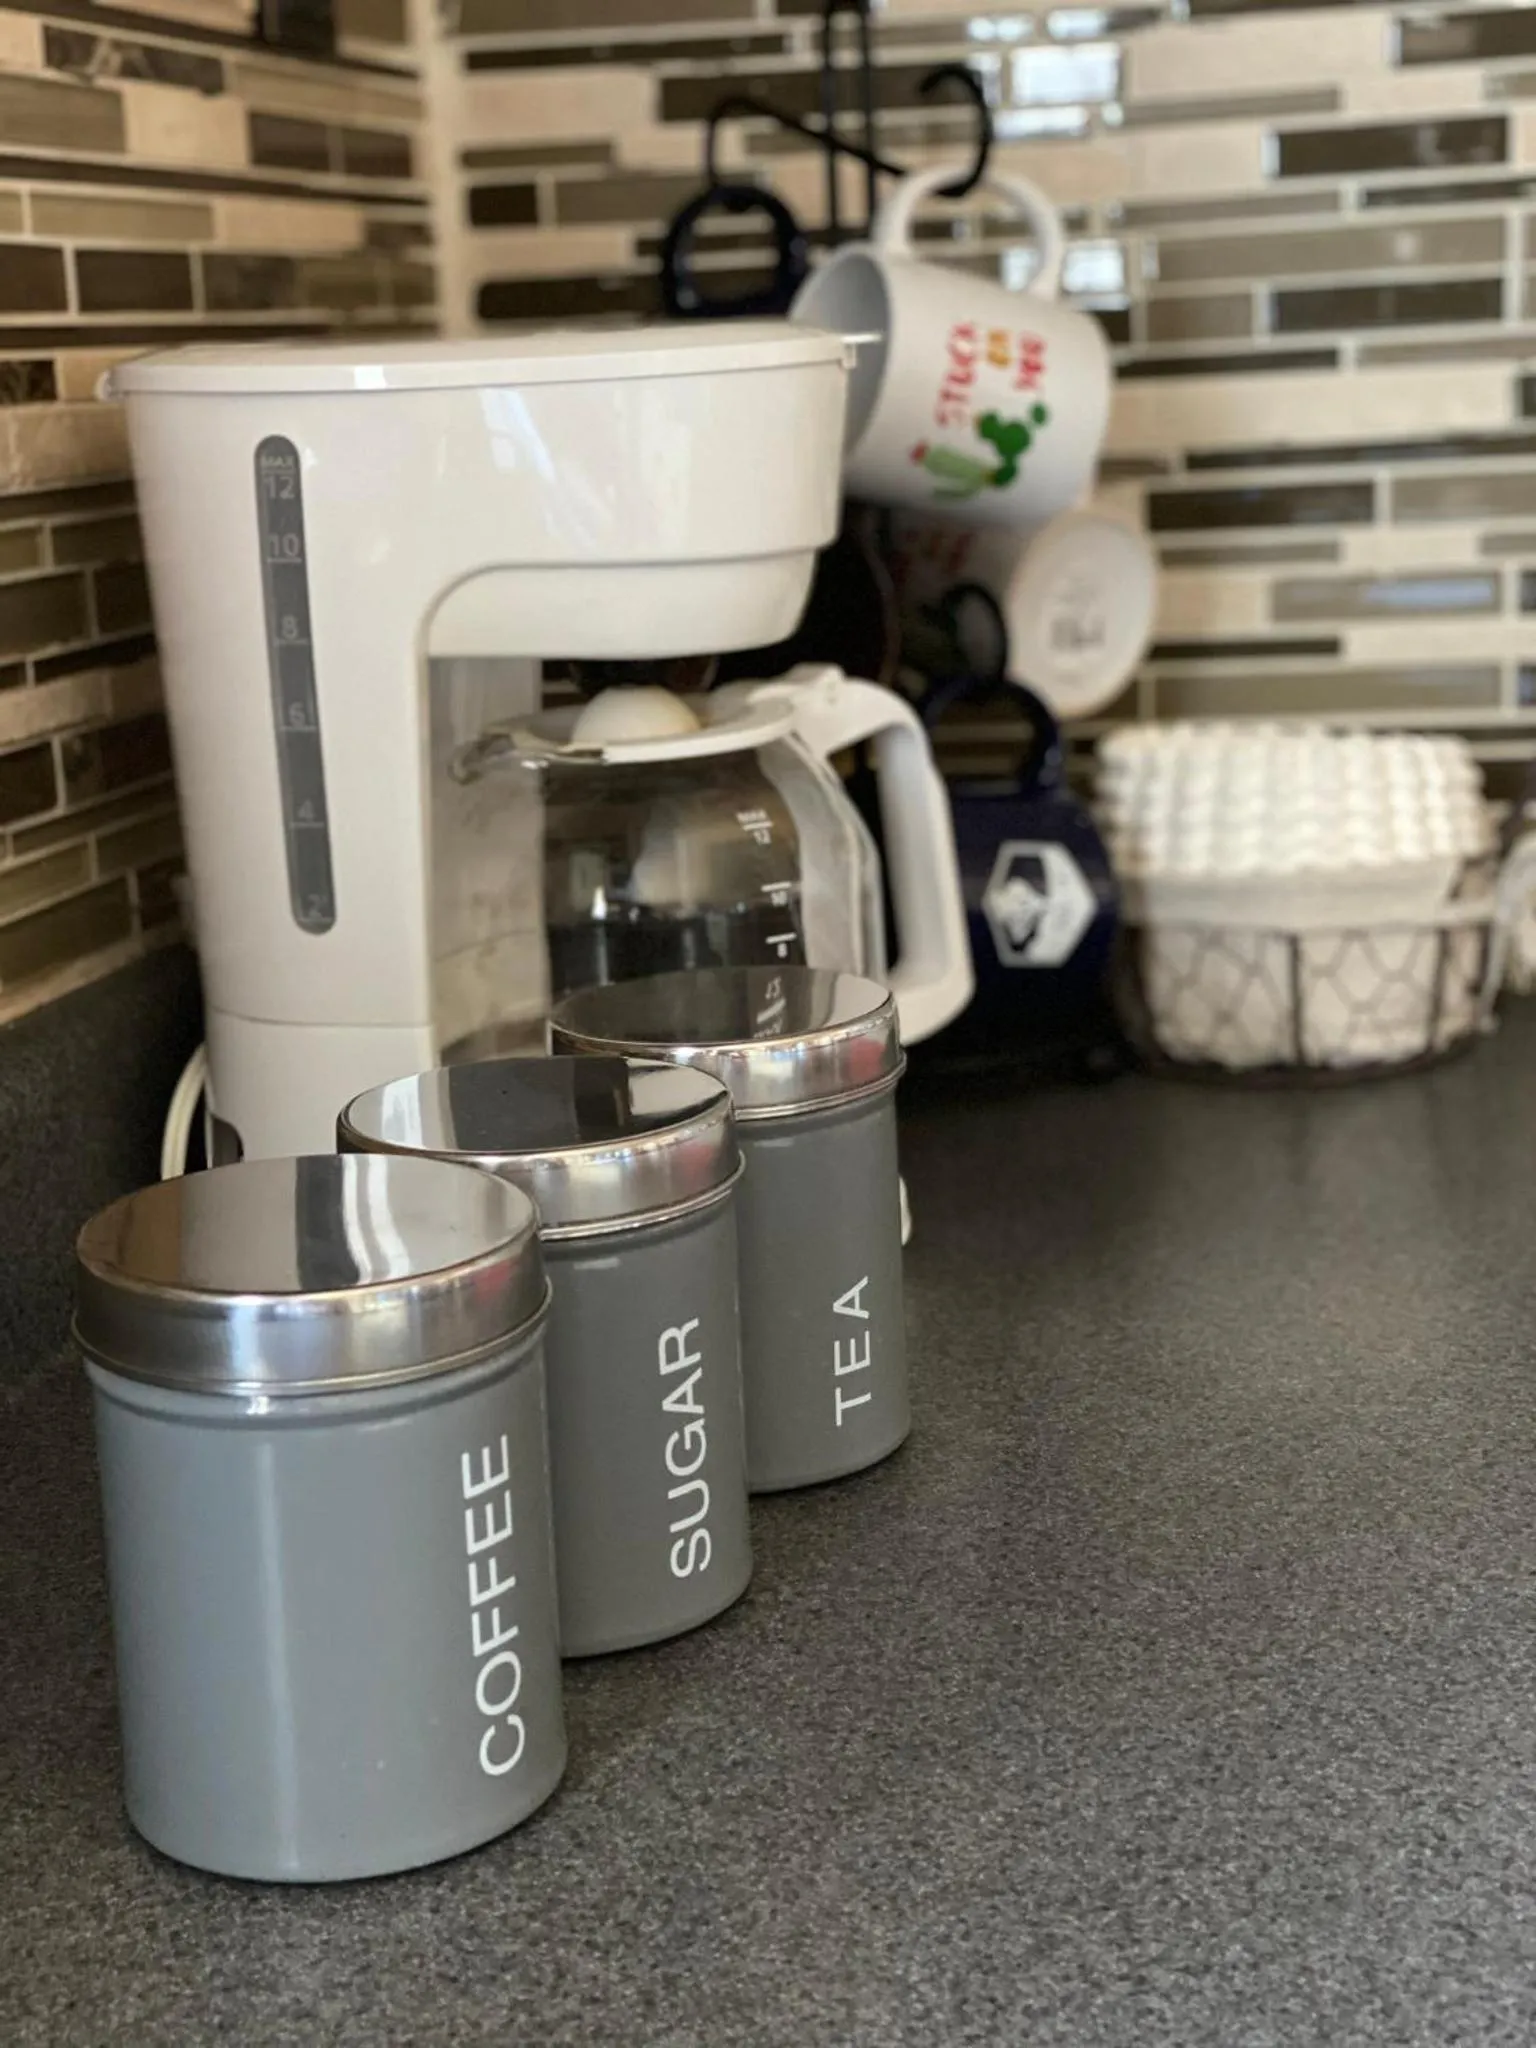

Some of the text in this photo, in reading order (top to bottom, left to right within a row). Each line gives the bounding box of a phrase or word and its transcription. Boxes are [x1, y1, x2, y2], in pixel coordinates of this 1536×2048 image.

[261, 456, 295, 469] MAX
[264, 476, 295, 499] 12
[267, 533, 300, 556] 10
[281, 616, 299, 639] 8
[297, 800, 316, 821] 4
[833, 1276, 872, 1427] TEA
[658, 1317, 712, 1579] SUGAR
[461, 1434, 525, 1777] COFFEE
